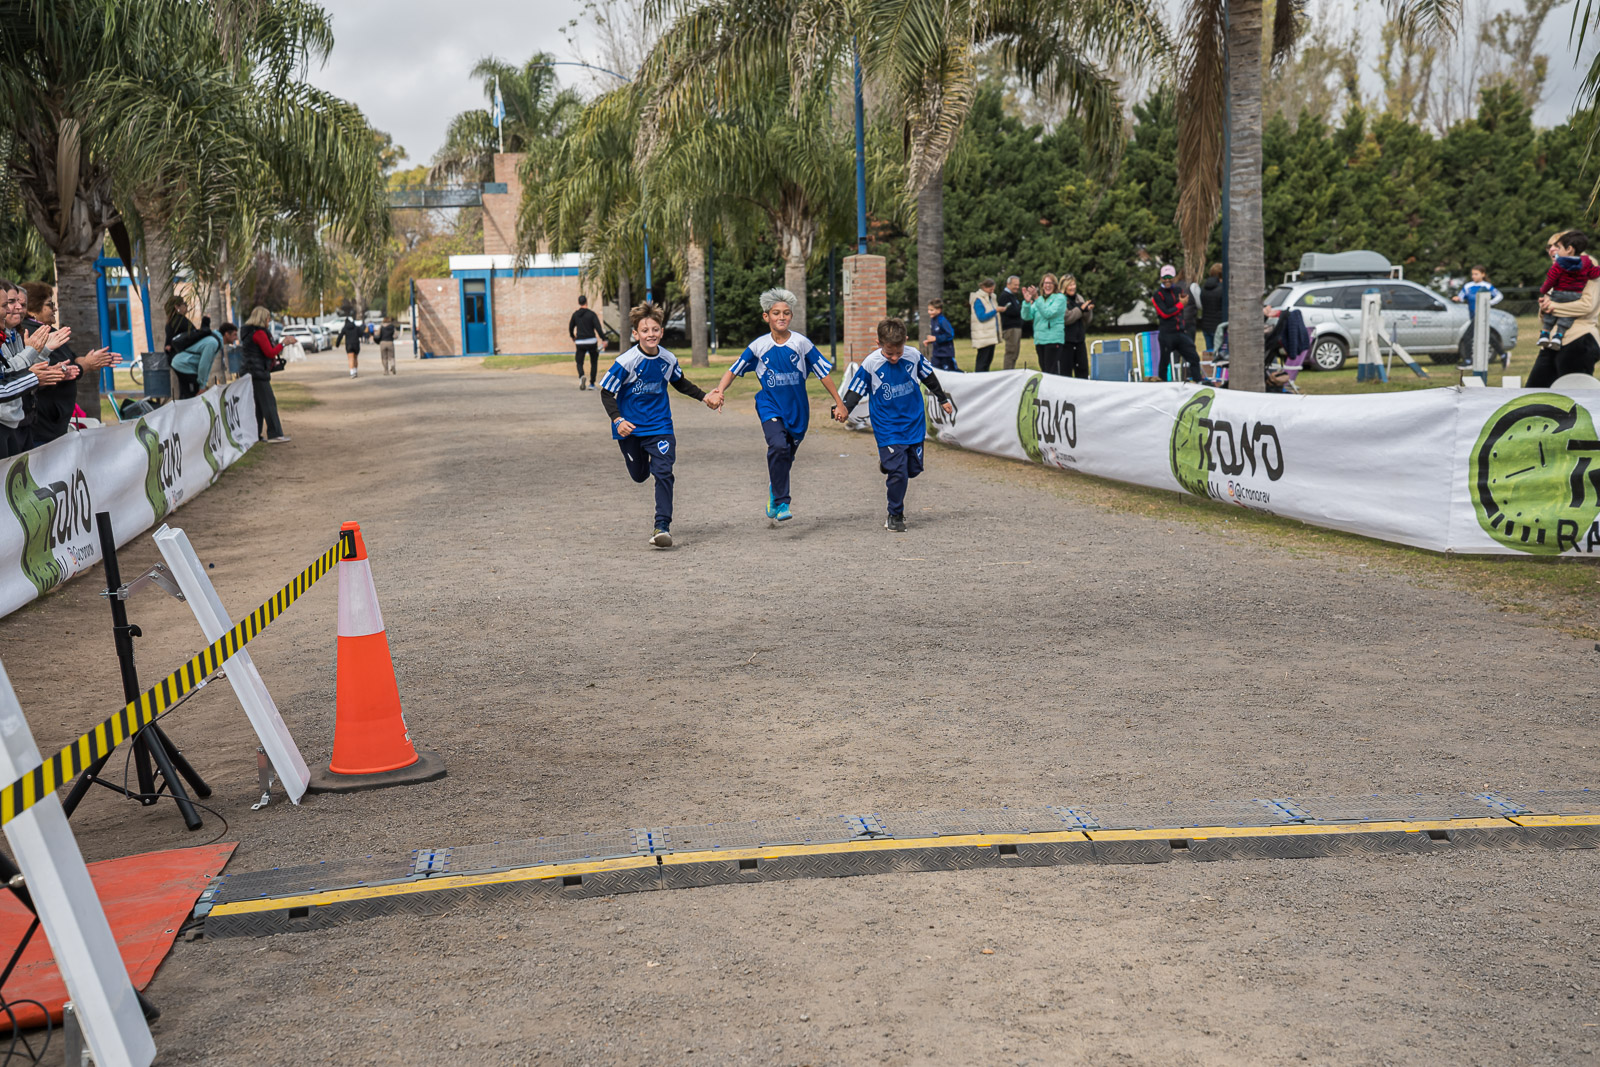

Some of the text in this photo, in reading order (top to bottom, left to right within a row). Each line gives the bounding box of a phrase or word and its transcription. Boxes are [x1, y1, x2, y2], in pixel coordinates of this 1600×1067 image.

[632, 378, 643, 395] 3
[766, 368, 776, 388] 3
[881, 382, 892, 401] 3
[1234, 482, 1271, 504] @cronorav
